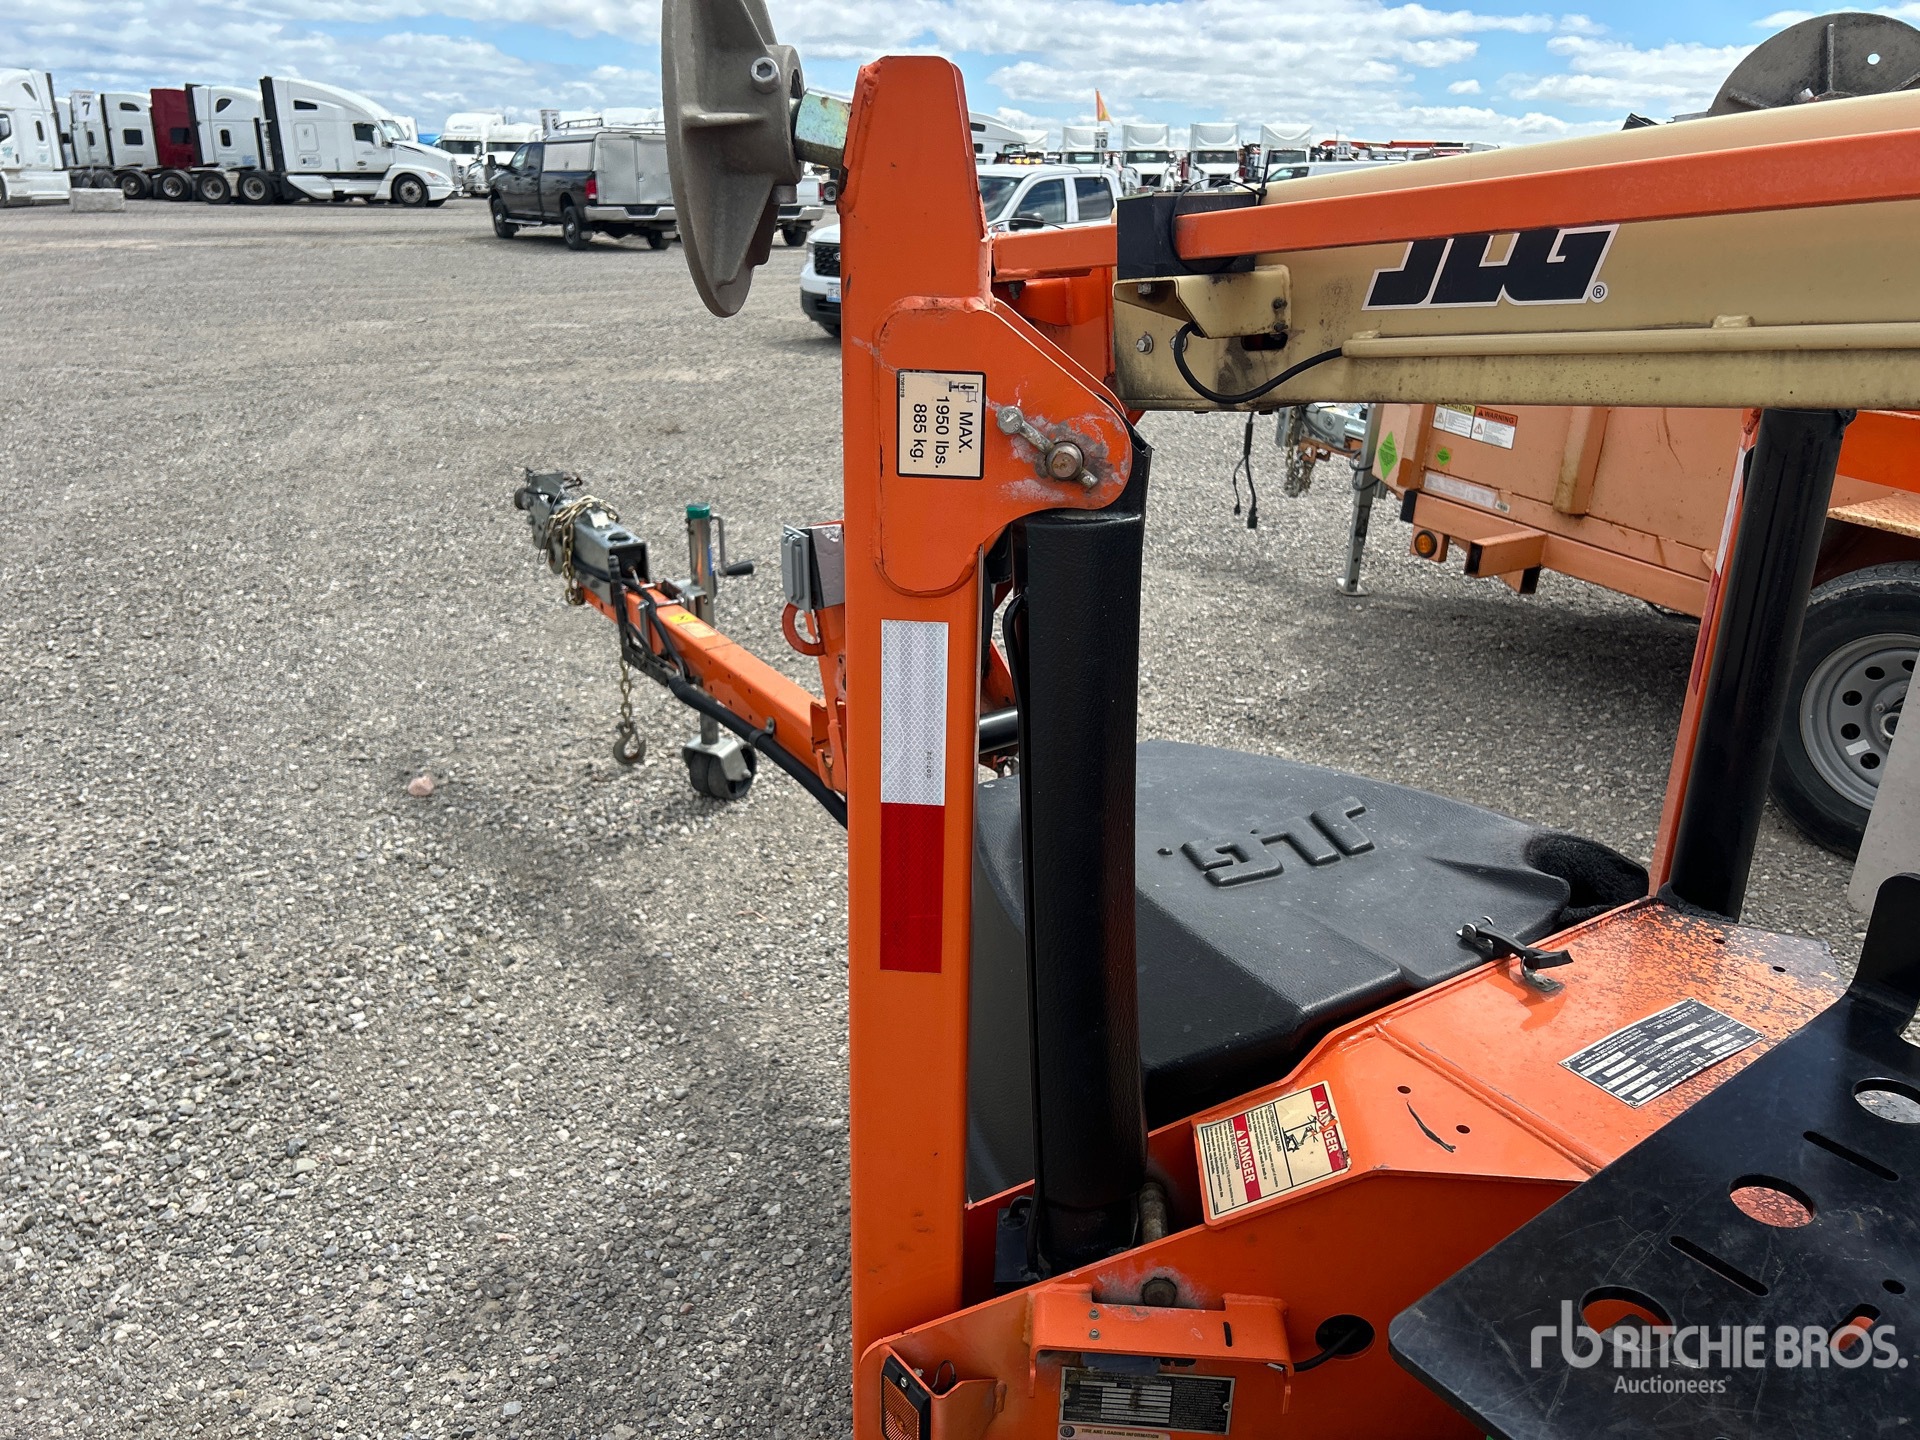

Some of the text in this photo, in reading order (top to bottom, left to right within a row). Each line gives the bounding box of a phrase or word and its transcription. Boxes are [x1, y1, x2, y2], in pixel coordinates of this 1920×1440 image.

[81, 101, 91, 116] 7
[1095, 138, 1108, 148] 10
[1337, 146, 1348, 155] 11
[1362, 224, 1619, 310] JLG
[909, 403, 928, 463] 885 kg.
[935, 396, 950, 469] 1950 lbs.
[958, 411, 974, 453] MAX.
[1485, 410, 1514, 424] WARNING
[1181, 796, 1375, 887] JLG
[1237, 1137, 1255, 1183] DANGER
